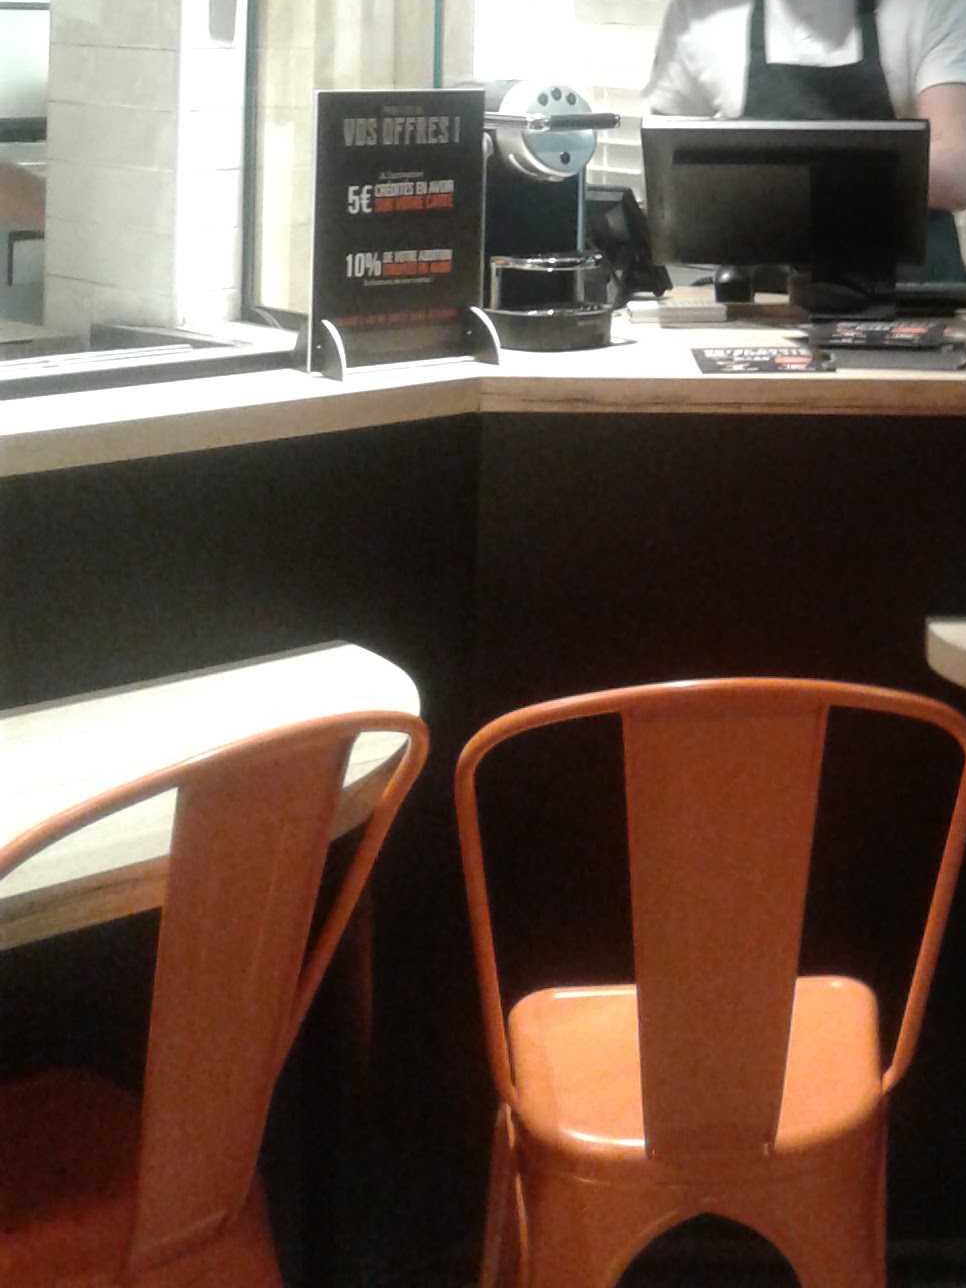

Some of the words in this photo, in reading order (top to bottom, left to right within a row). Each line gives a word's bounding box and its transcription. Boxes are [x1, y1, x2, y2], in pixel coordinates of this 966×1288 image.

[383, 116, 449, 145] OFFRES
[347, 185, 373, 214] 5€
[346, 252, 381, 277] 10%
